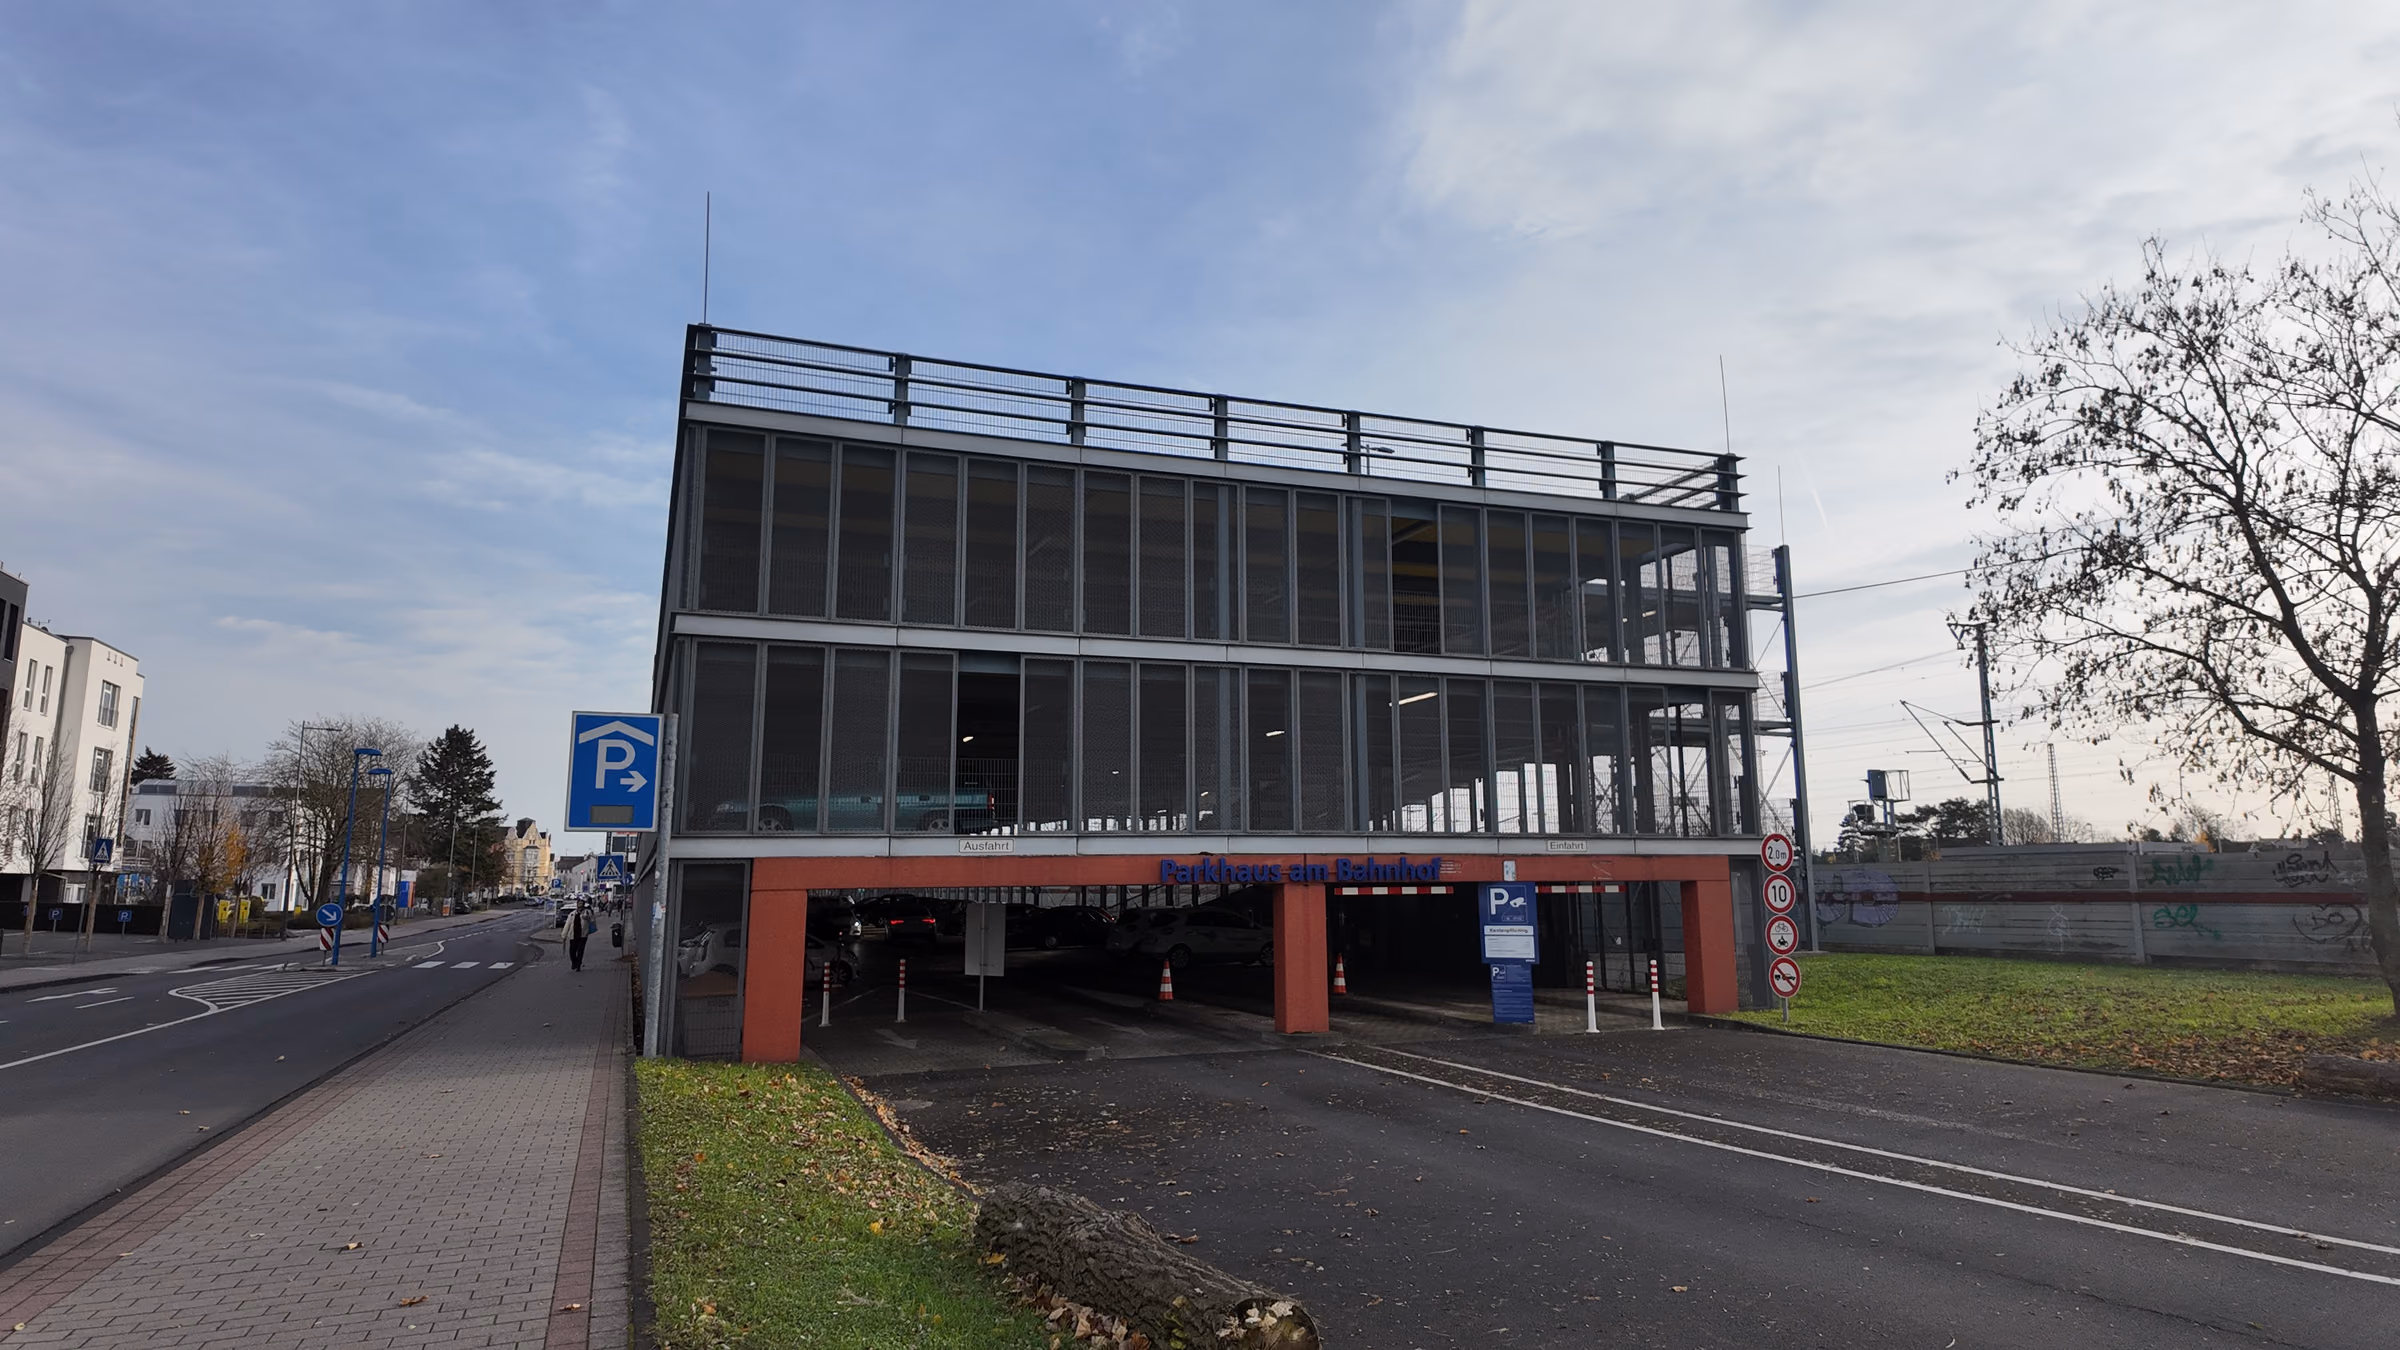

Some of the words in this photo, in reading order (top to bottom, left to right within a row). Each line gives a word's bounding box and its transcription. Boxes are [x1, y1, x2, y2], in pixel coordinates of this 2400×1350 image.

[595, 739, 636, 789] P
[963, 841, 1010, 851] Ausfahrt
[1550, 841, 1585, 850] Einfahrt
[1160, 857, 1283, 884] Parkhaus
[1289, 863, 1329, 883] am
[1336, 856, 1442, 882] Bahnhof
[1489, 888, 1509, 915] P
[1771, 885, 1787, 903] 10
[1492, 967, 1500, 977] P
